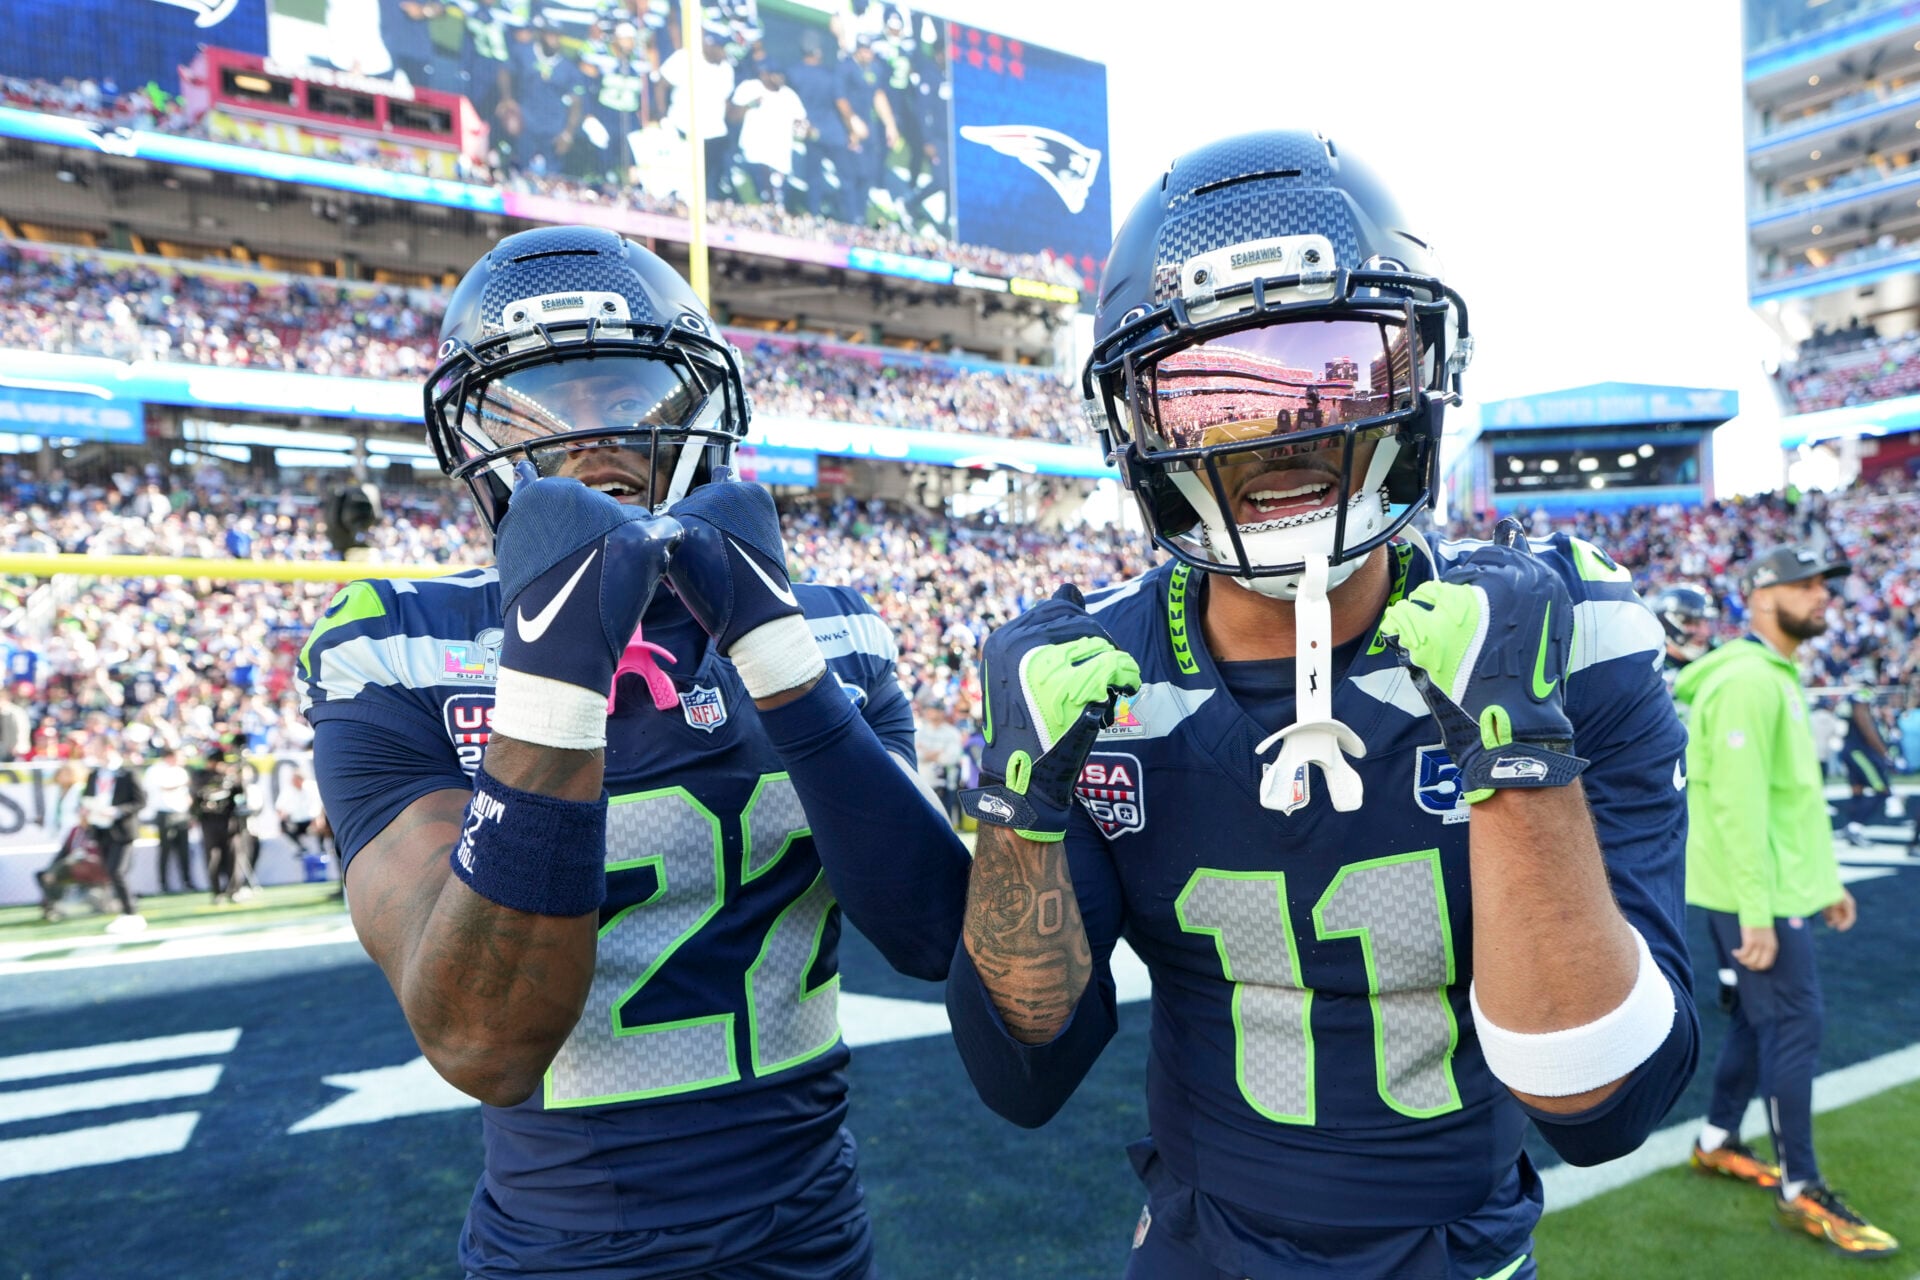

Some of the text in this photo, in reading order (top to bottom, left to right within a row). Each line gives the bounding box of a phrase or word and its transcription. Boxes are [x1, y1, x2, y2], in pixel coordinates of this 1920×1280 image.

[1230, 246, 1283, 268] SEAHAWKS
[541, 296, 584, 311] SEAHAWKS
[689, 704, 720, 724] NFL
[1077, 764, 1134, 787] SA
[544, 771, 842, 1110] 22
[1174, 848, 1463, 1126] 11
